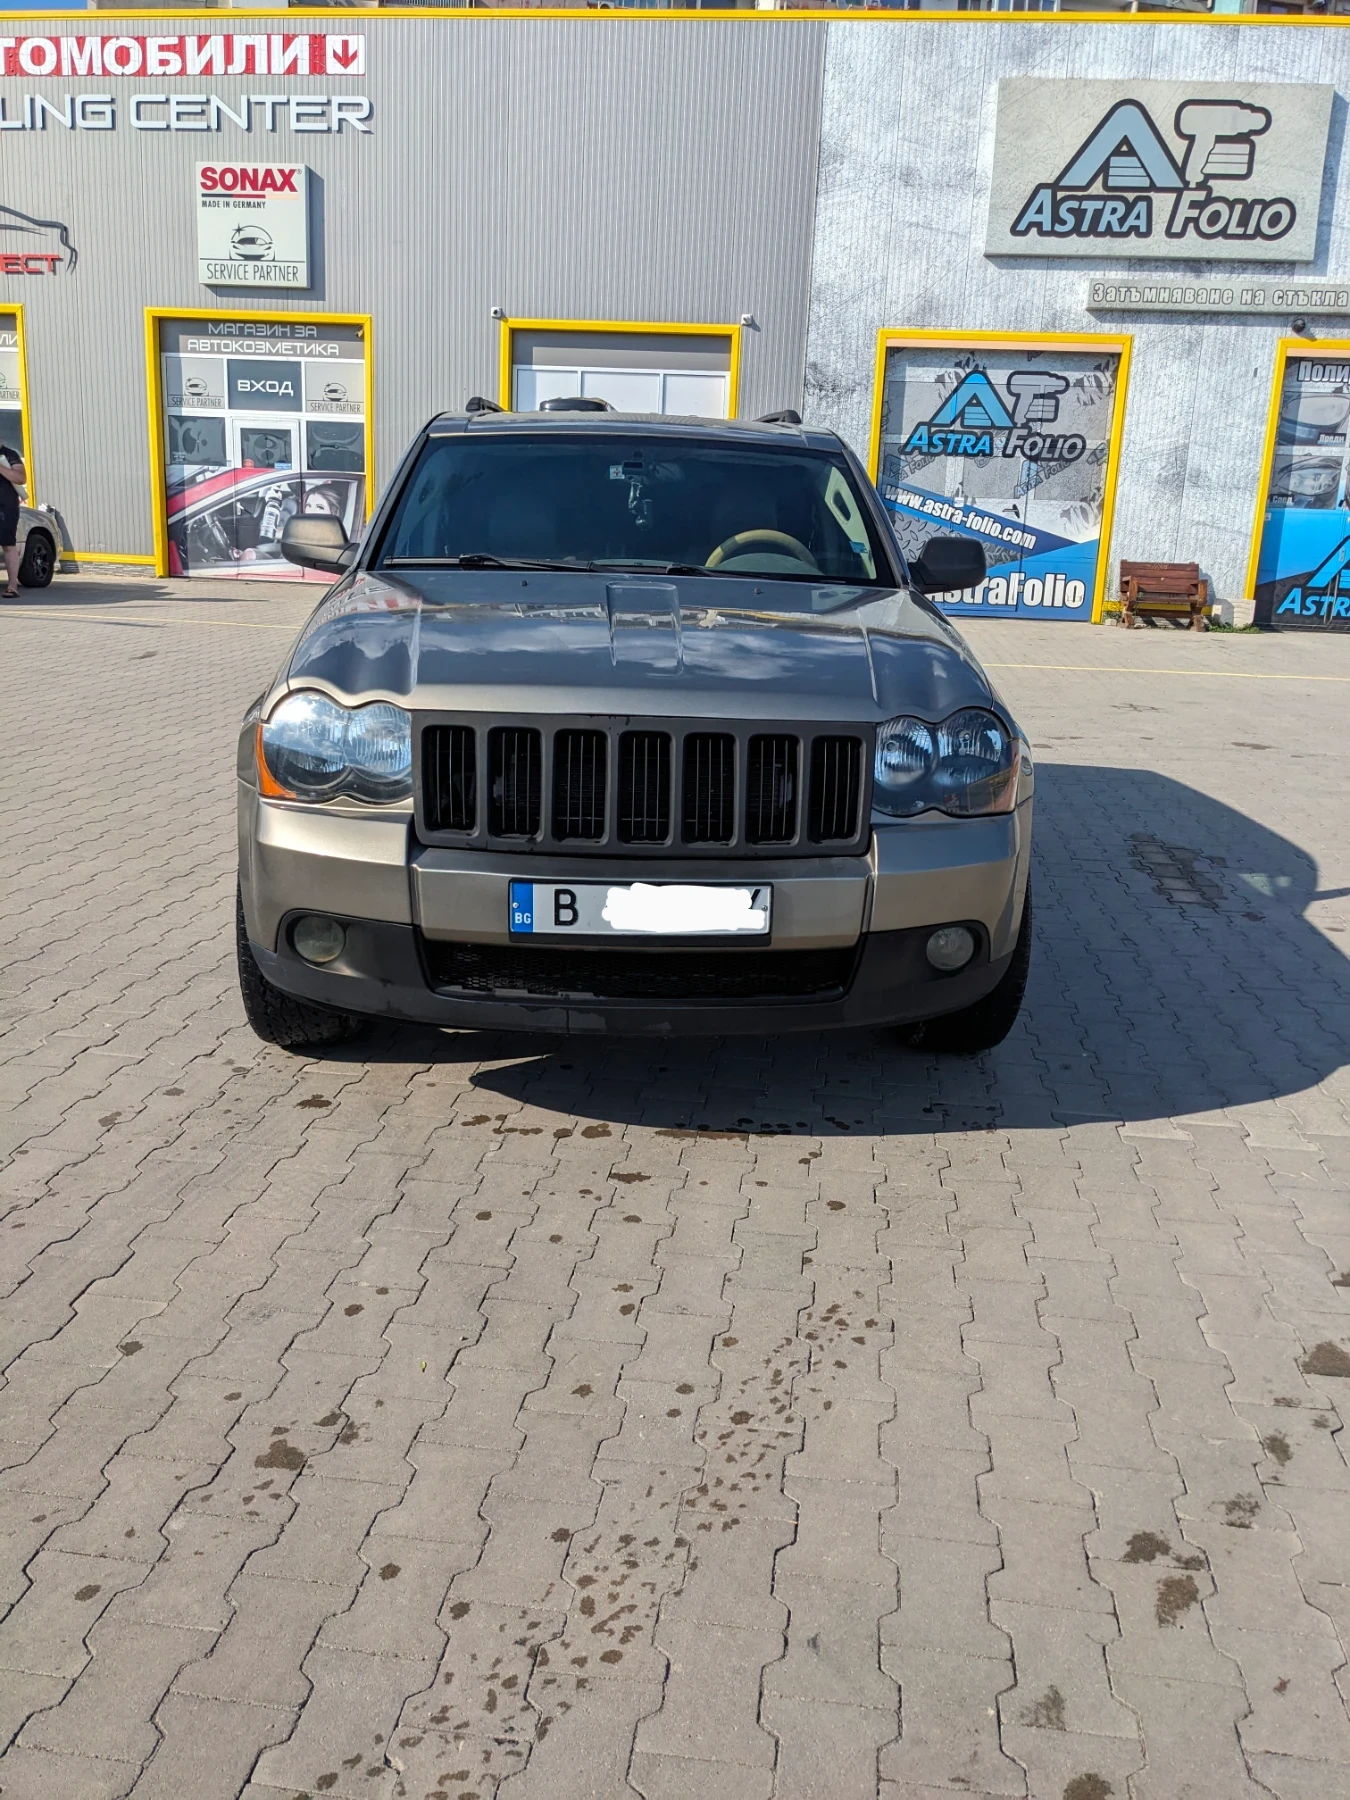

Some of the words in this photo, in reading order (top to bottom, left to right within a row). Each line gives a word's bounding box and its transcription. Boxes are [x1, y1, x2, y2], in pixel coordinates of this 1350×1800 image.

[0, 94, 113, 129] LING
[130, 94, 372, 131] CENTER
[201, 200, 221, 208] MADE
[233, 201, 266, 209] GERMANY
[1013, 187, 1150, 235] ASTRA
[1168, 189, 1293, 237] FOLIO
[0, 254, 61, 273] ECT
[206, 263, 249, 280] SERVICE
[253, 264, 299, 282] PARTNER
[1092, 283, 1234, 305] Затъмняване
[1240, 287, 1266, 306] на
[1272, 289, 1349, 308] стъкла
[208, 323, 290, 337] МАГАЗИН
[294, 325, 317, 338] ЗА
[187, 339, 340, 356] АВТОКОЗМЕТИКА
[1298, 360, 1350, 383] Поли
[237, 379, 294, 397] ВХОД
[172, 397, 196, 407] SERVICE
[197, 397, 222, 407] PARTNER
[310, 402, 335, 412] SERVICE
[336, 403, 361, 413] PARTNER
[903, 424, 992, 455] ASTRA
[1003, 427, 1086, 460] FOLIO
[884, 484, 1038, 550] www.astra-folio.com
[1276, 588, 1350, 617] ASTR
[514, 912, 531, 924] BG
[554, 888, 579, 926] B
